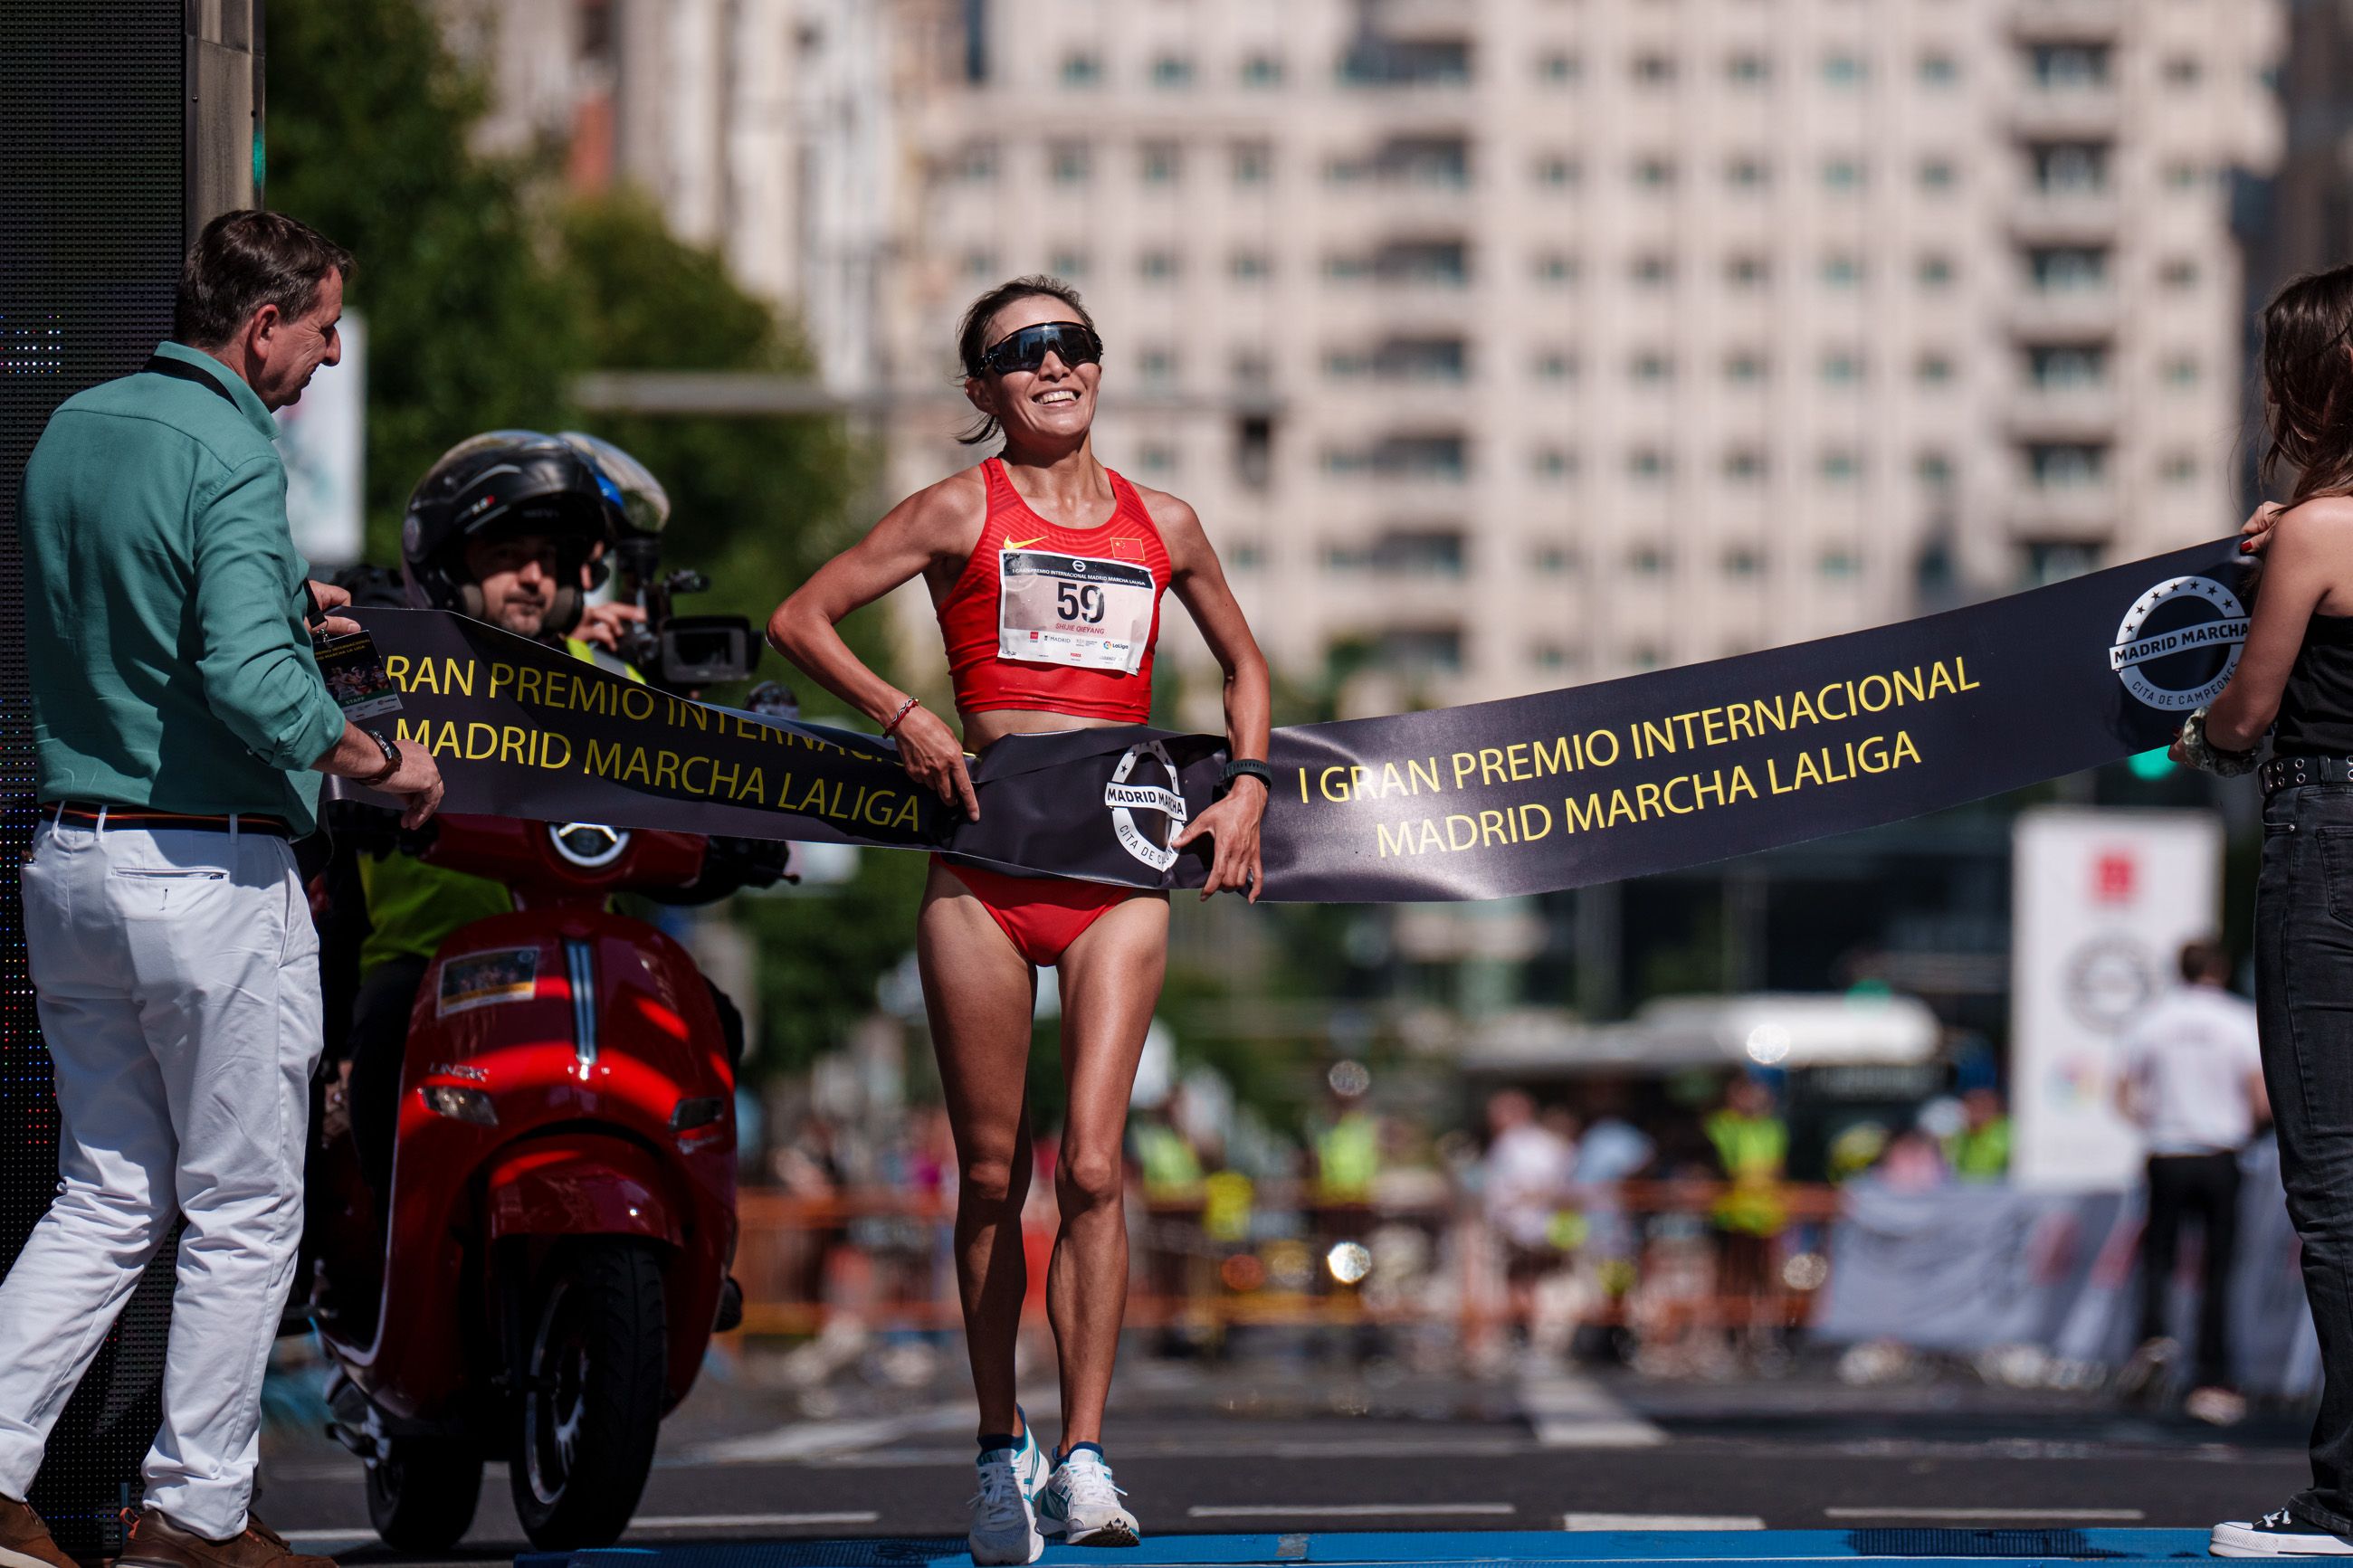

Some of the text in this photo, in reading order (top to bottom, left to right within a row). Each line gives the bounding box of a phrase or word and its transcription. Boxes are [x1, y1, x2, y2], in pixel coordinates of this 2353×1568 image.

[1057, 581, 1105, 623] 59
[1055, 622, 1105, 635] SHIJIE QIEYANG
[2114, 623, 2249, 663] MADRID MARCHA
[381, 654, 475, 696] RAN
[489, 662, 654, 720] PREMIO
[2132, 680, 2154, 700] CITA
[2158, 695, 2173, 705] DE
[1299, 656, 1981, 804] I GRAN PREMIO INTERNACIONAL
[395, 717, 919, 832] MADRID MARCHA LALIGA
[1377, 729, 1921, 860] MADRID MARCHA LALIGA
[1107, 788, 1185, 815] MADRID MARCHA
[1119, 824, 1138, 850] CITA
[1140, 846, 1155, 860] DE
